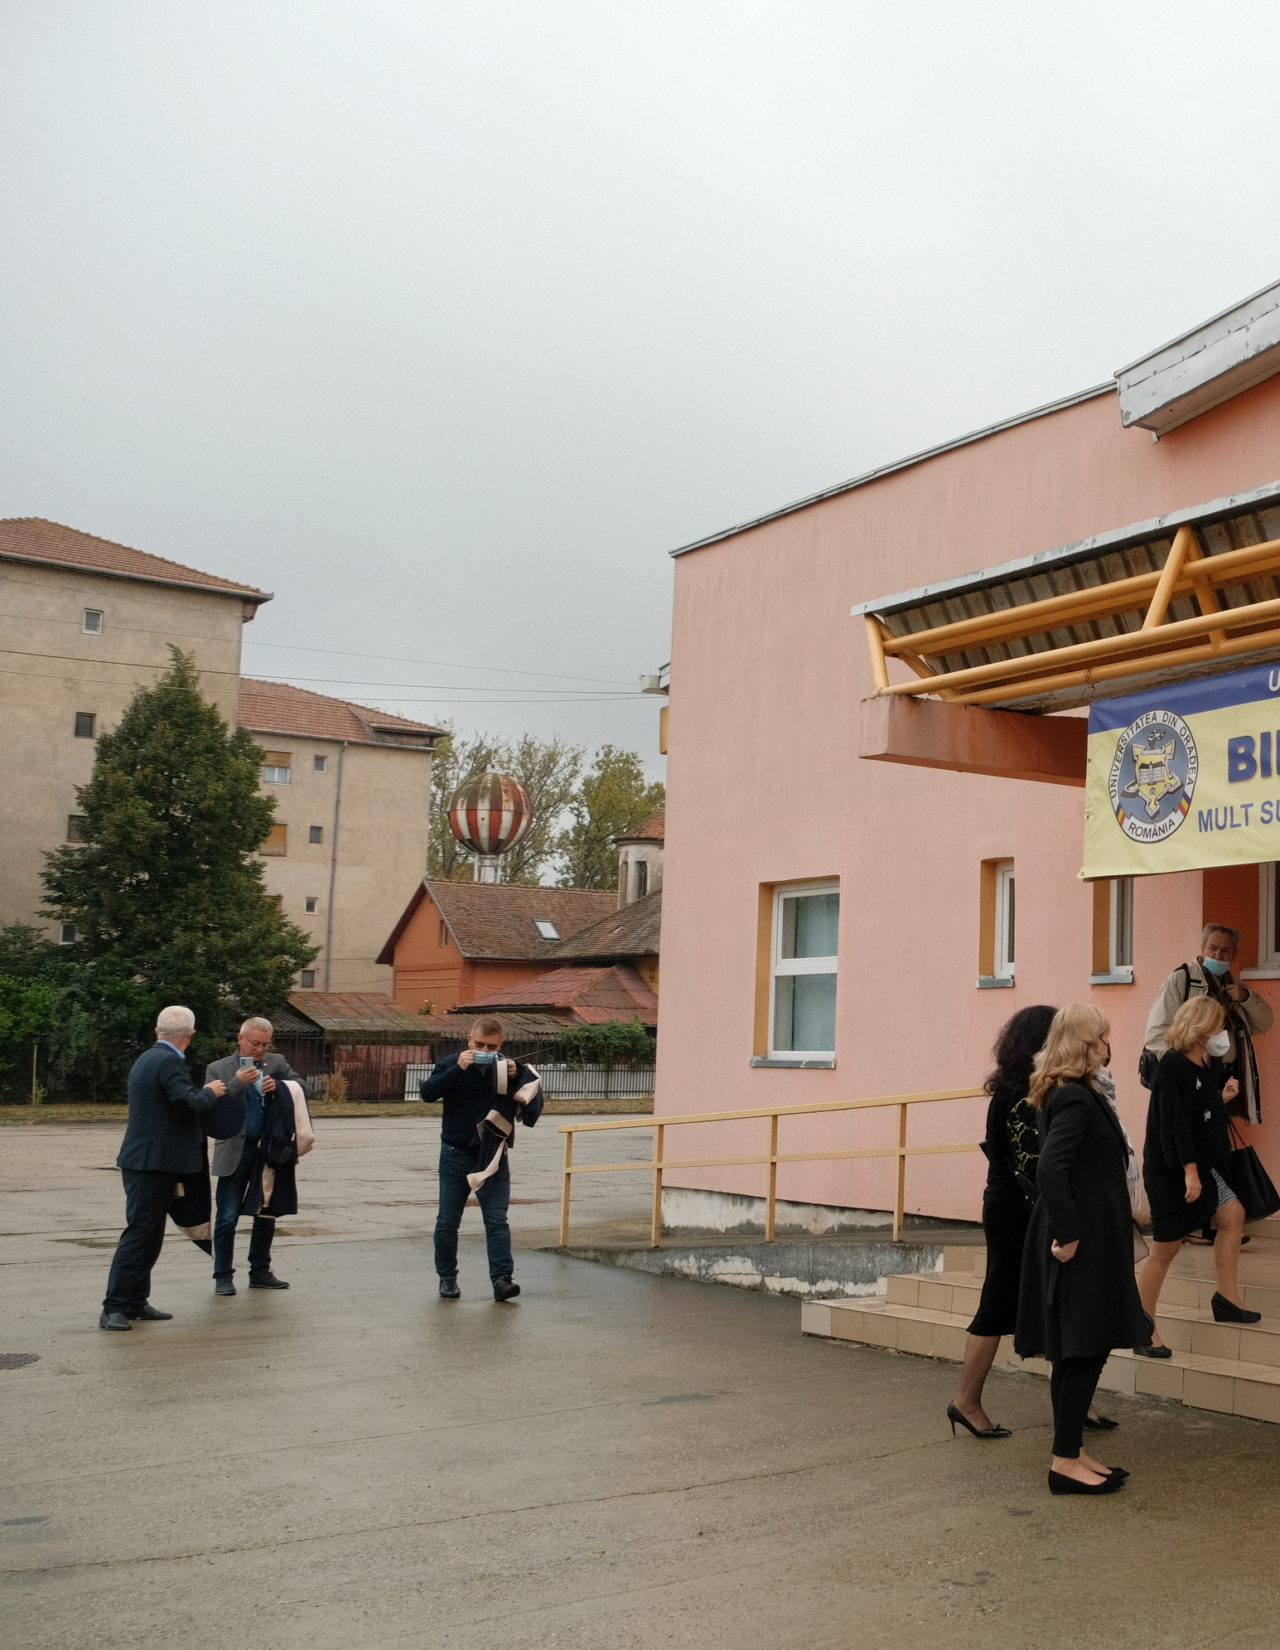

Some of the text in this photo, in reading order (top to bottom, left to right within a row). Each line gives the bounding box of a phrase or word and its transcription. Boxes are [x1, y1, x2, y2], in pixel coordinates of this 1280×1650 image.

[1110, 711, 1198, 799] UNIVERSITATEA DIN ORADEA
[1127, 821, 1176, 839] ROMÂNIA
[1198, 803, 1253, 833] MULT
